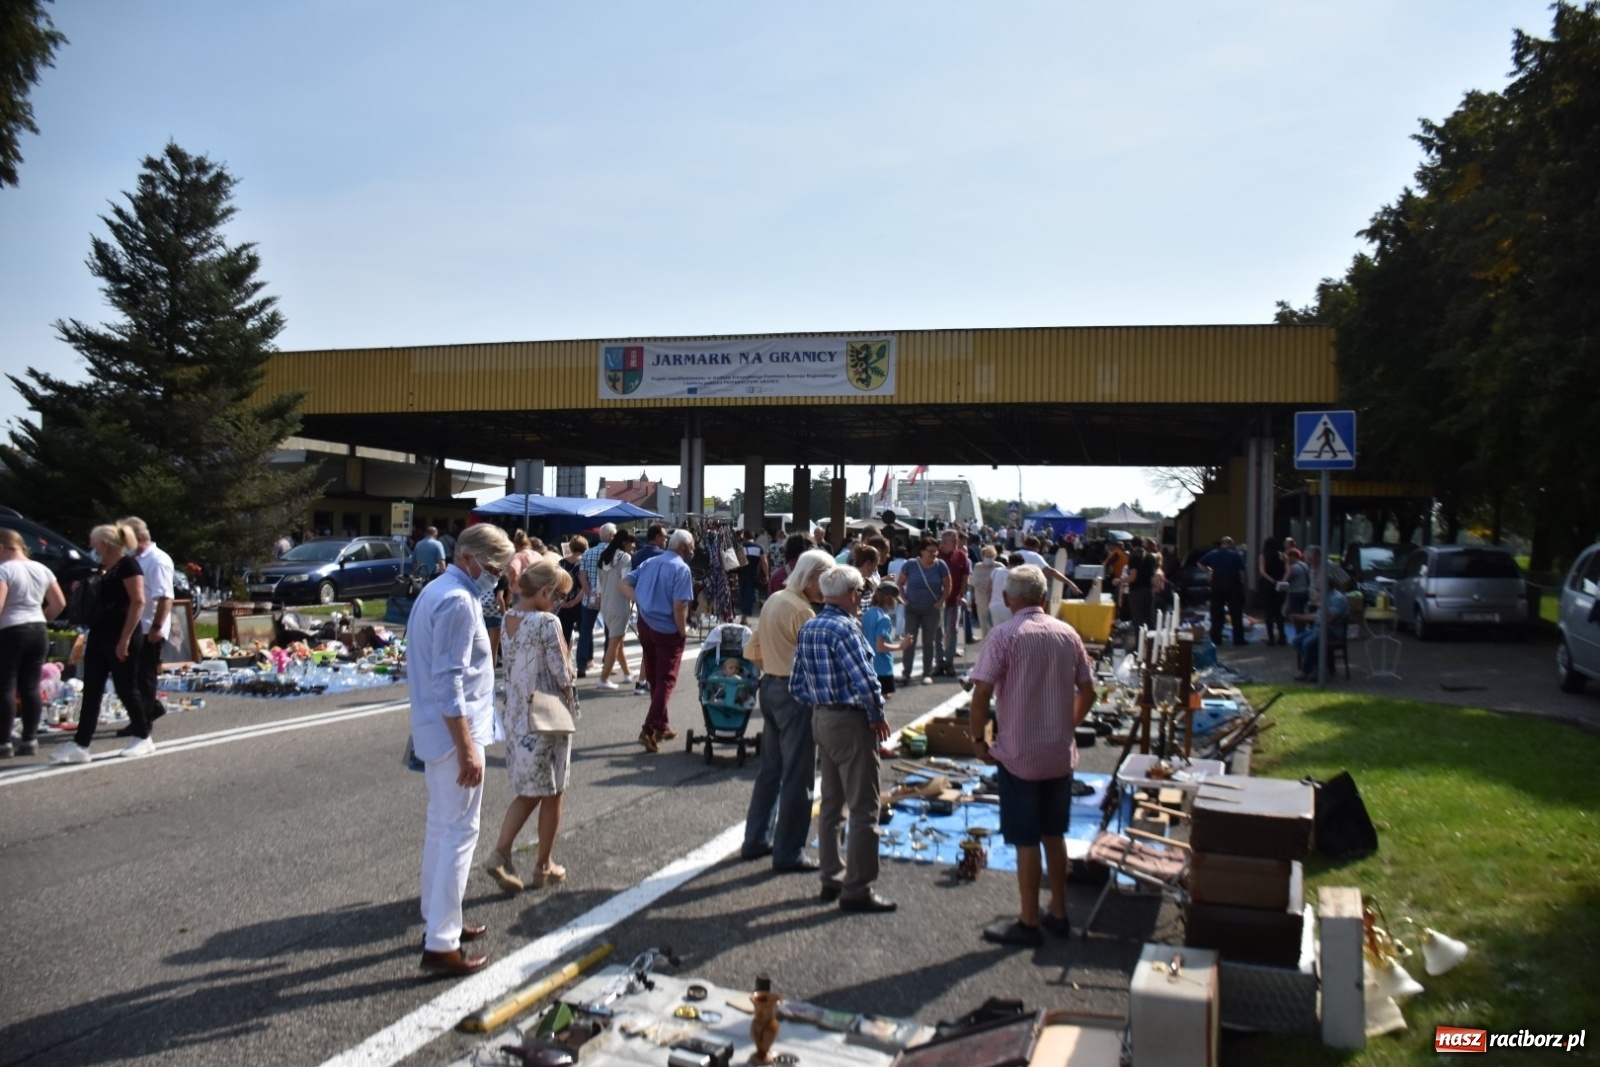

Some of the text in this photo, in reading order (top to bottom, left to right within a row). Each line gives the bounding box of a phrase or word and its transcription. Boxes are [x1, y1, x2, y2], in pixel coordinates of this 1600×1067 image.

[652, 350, 838, 367] JARMARK NA GRANICY
